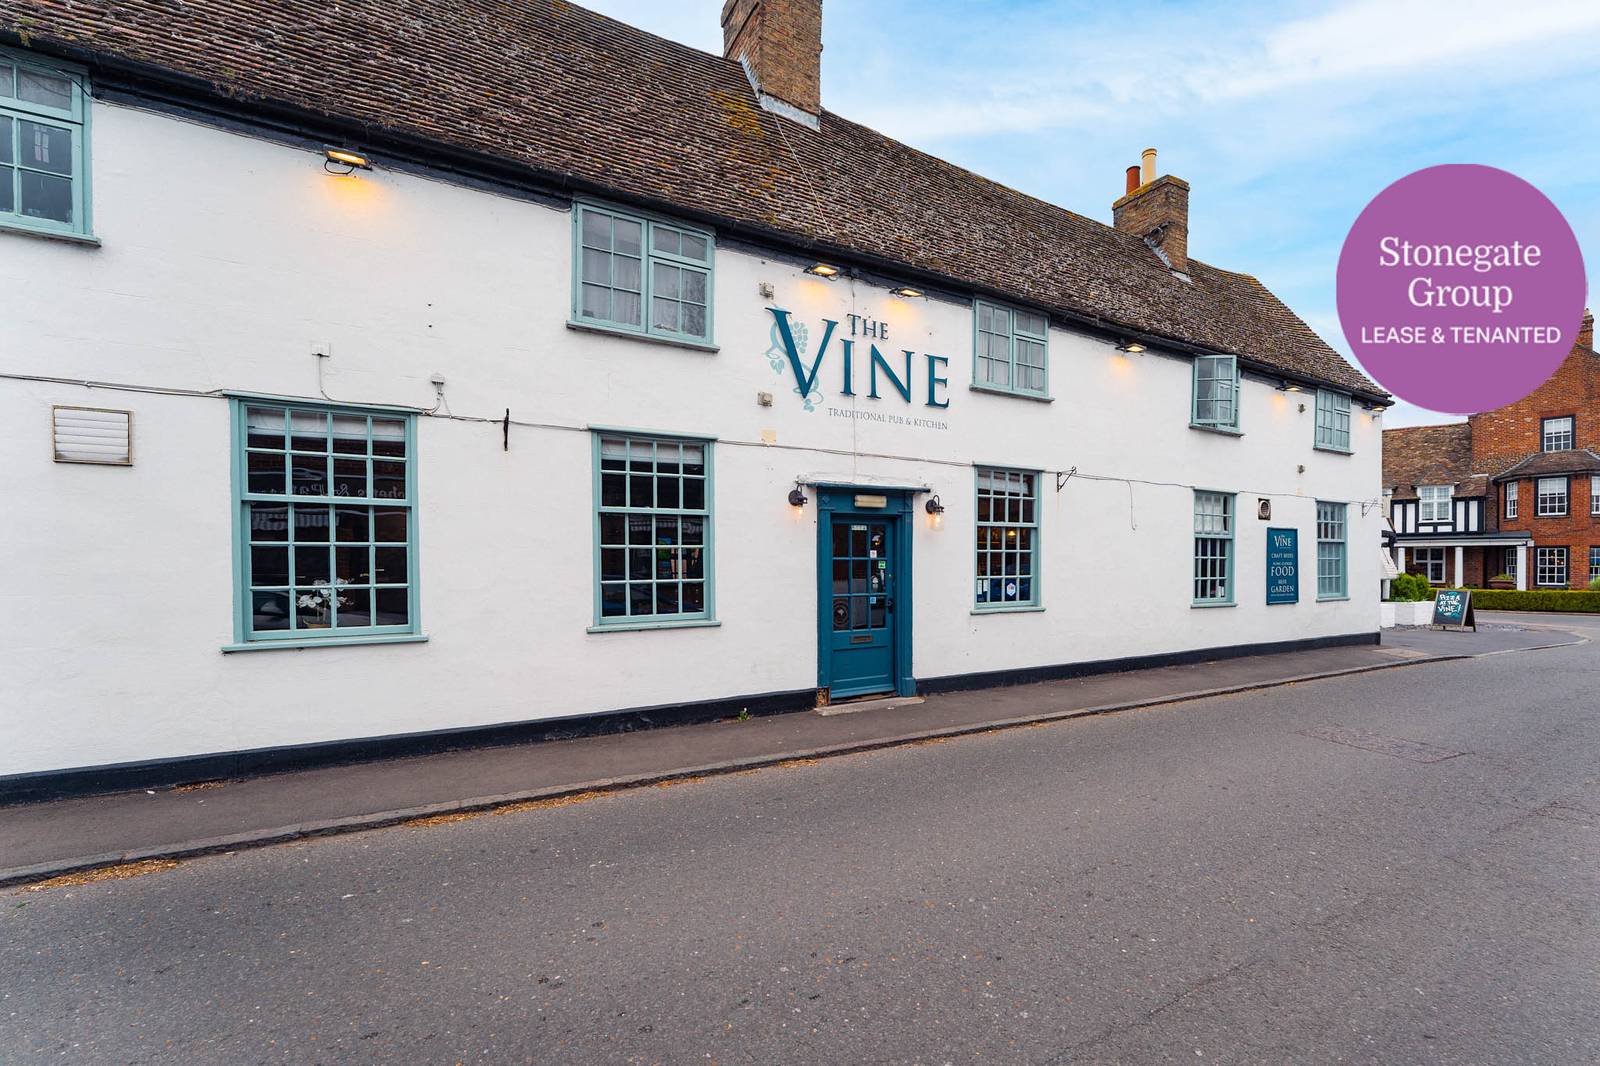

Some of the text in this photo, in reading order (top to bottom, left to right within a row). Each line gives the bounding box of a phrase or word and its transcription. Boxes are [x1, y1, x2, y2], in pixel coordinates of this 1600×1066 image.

[847, 313, 889, 340] THE
[765, 306, 950, 409] VINE
[828, 408, 948, 430] TRADITIONAL PUB & KITCHEN
[1274, 535, 1292, 547] VINE
[1271, 566, 1295, 576] FOOD
[1270, 585, 1294, 593] GARDEN
